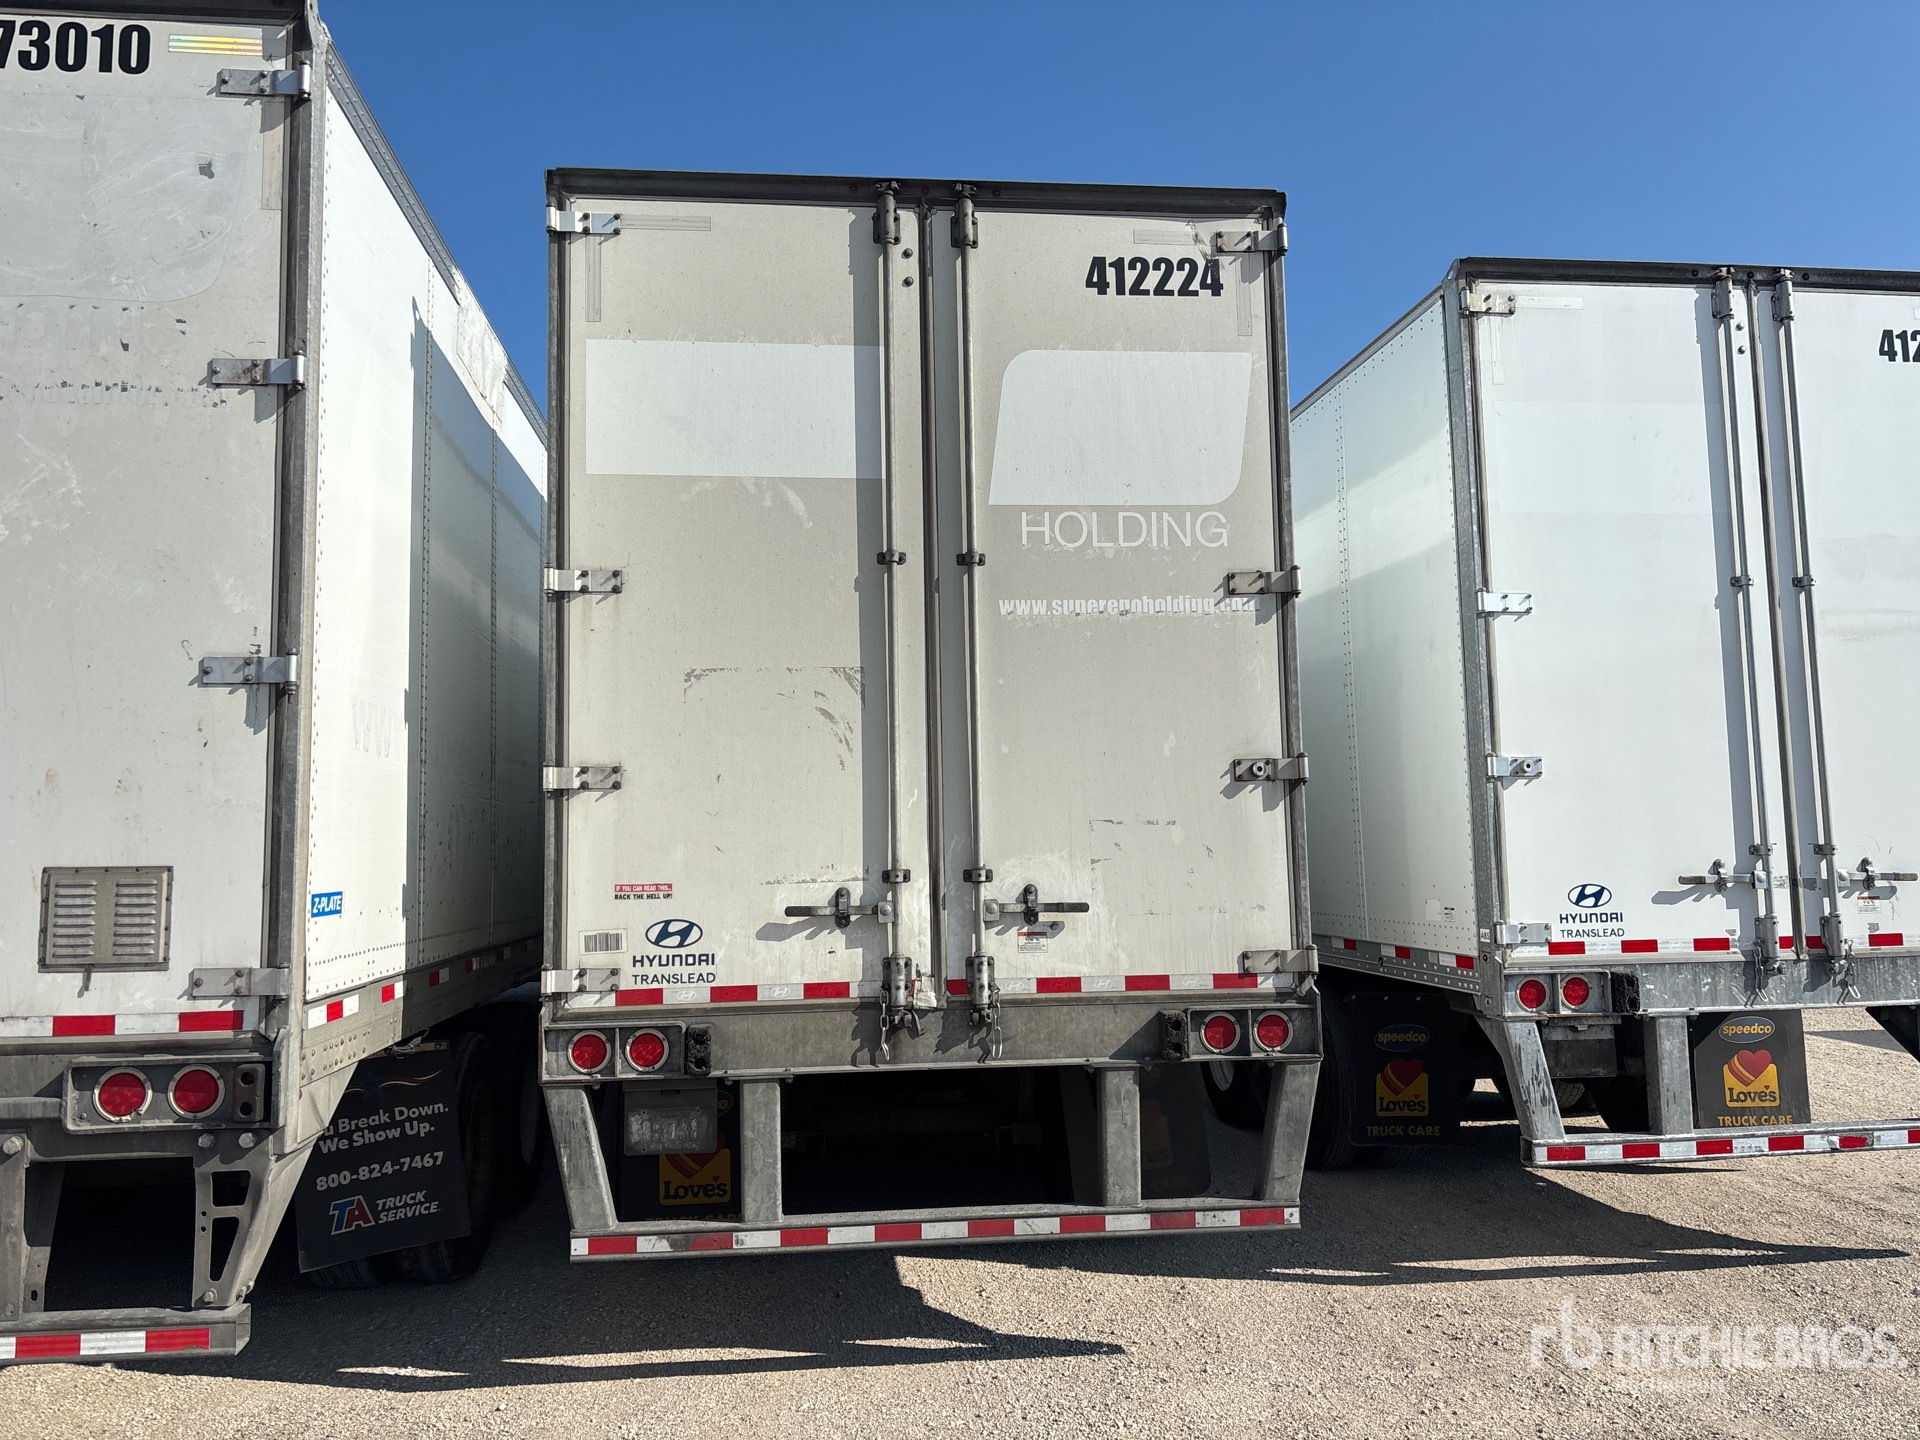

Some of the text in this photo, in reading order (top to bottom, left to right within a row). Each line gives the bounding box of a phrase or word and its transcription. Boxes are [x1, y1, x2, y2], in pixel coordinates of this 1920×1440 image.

[1085, 256, 1223, 297] 412224
[1021, 510, 1229, 548] HOLDING
[312, 895, 342, 914] Z-PLATE
[1559, 912, 1624, 924] HYUNDAI
[1481, 931, 1490, 940] ABS
[1560, 928, 1625, 939] TRANSLEAD
[632, 953, 716, 968] HYUNDAI
[632, 972, 716, 986] TRANSLEAD
[1377, 1031, 1427, 1044] speedco
[1722, 1023, 1772, 1036] speedco
[338, 1109, 391, 1134] Break
[394, 1102, 449, 1121] Down.
[1717, 1115, 1793, 1127] TRUCK CARE
[318, 1120, 435, 1154] We Show Up.
[1367, 1125, 1440, 1137] TRUCK CARE
[316, 1151, 444, 1191] 800-824-7467
[376, 1190, 427, 1211] TRUCK
[329, 1195, 375, 1235] TA
[378, 1201, 440, 1224] SERVICE
